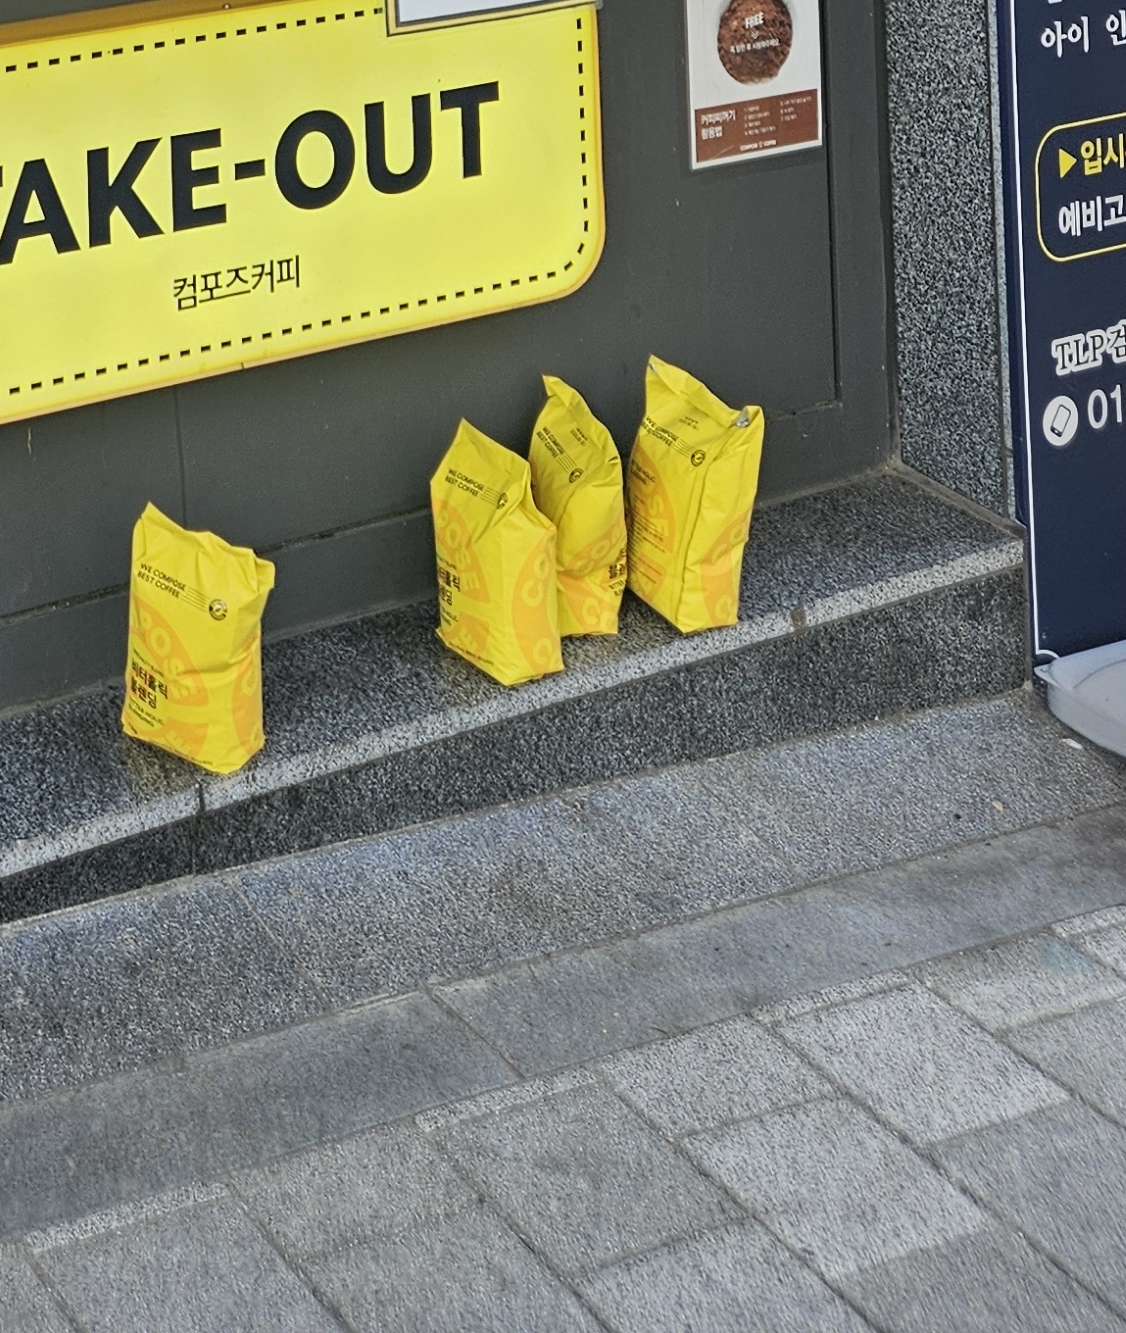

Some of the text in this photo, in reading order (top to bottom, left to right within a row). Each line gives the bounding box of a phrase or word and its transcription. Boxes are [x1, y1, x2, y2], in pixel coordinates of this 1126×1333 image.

[744, 11, 765, 30] FREE
[1040, 15, 1090, 58] 아이
[172, 254, 303, 312] 컴포즈커피
[1087, 384, 1123, 429] 01
[456, 472, 485, 492] COMPOSE
[457, 481, 480, 498] COFFEE
[137, 571, 181, 600] BEST COFFEE
[140, 562, 187, 592] WE COMPOSE
